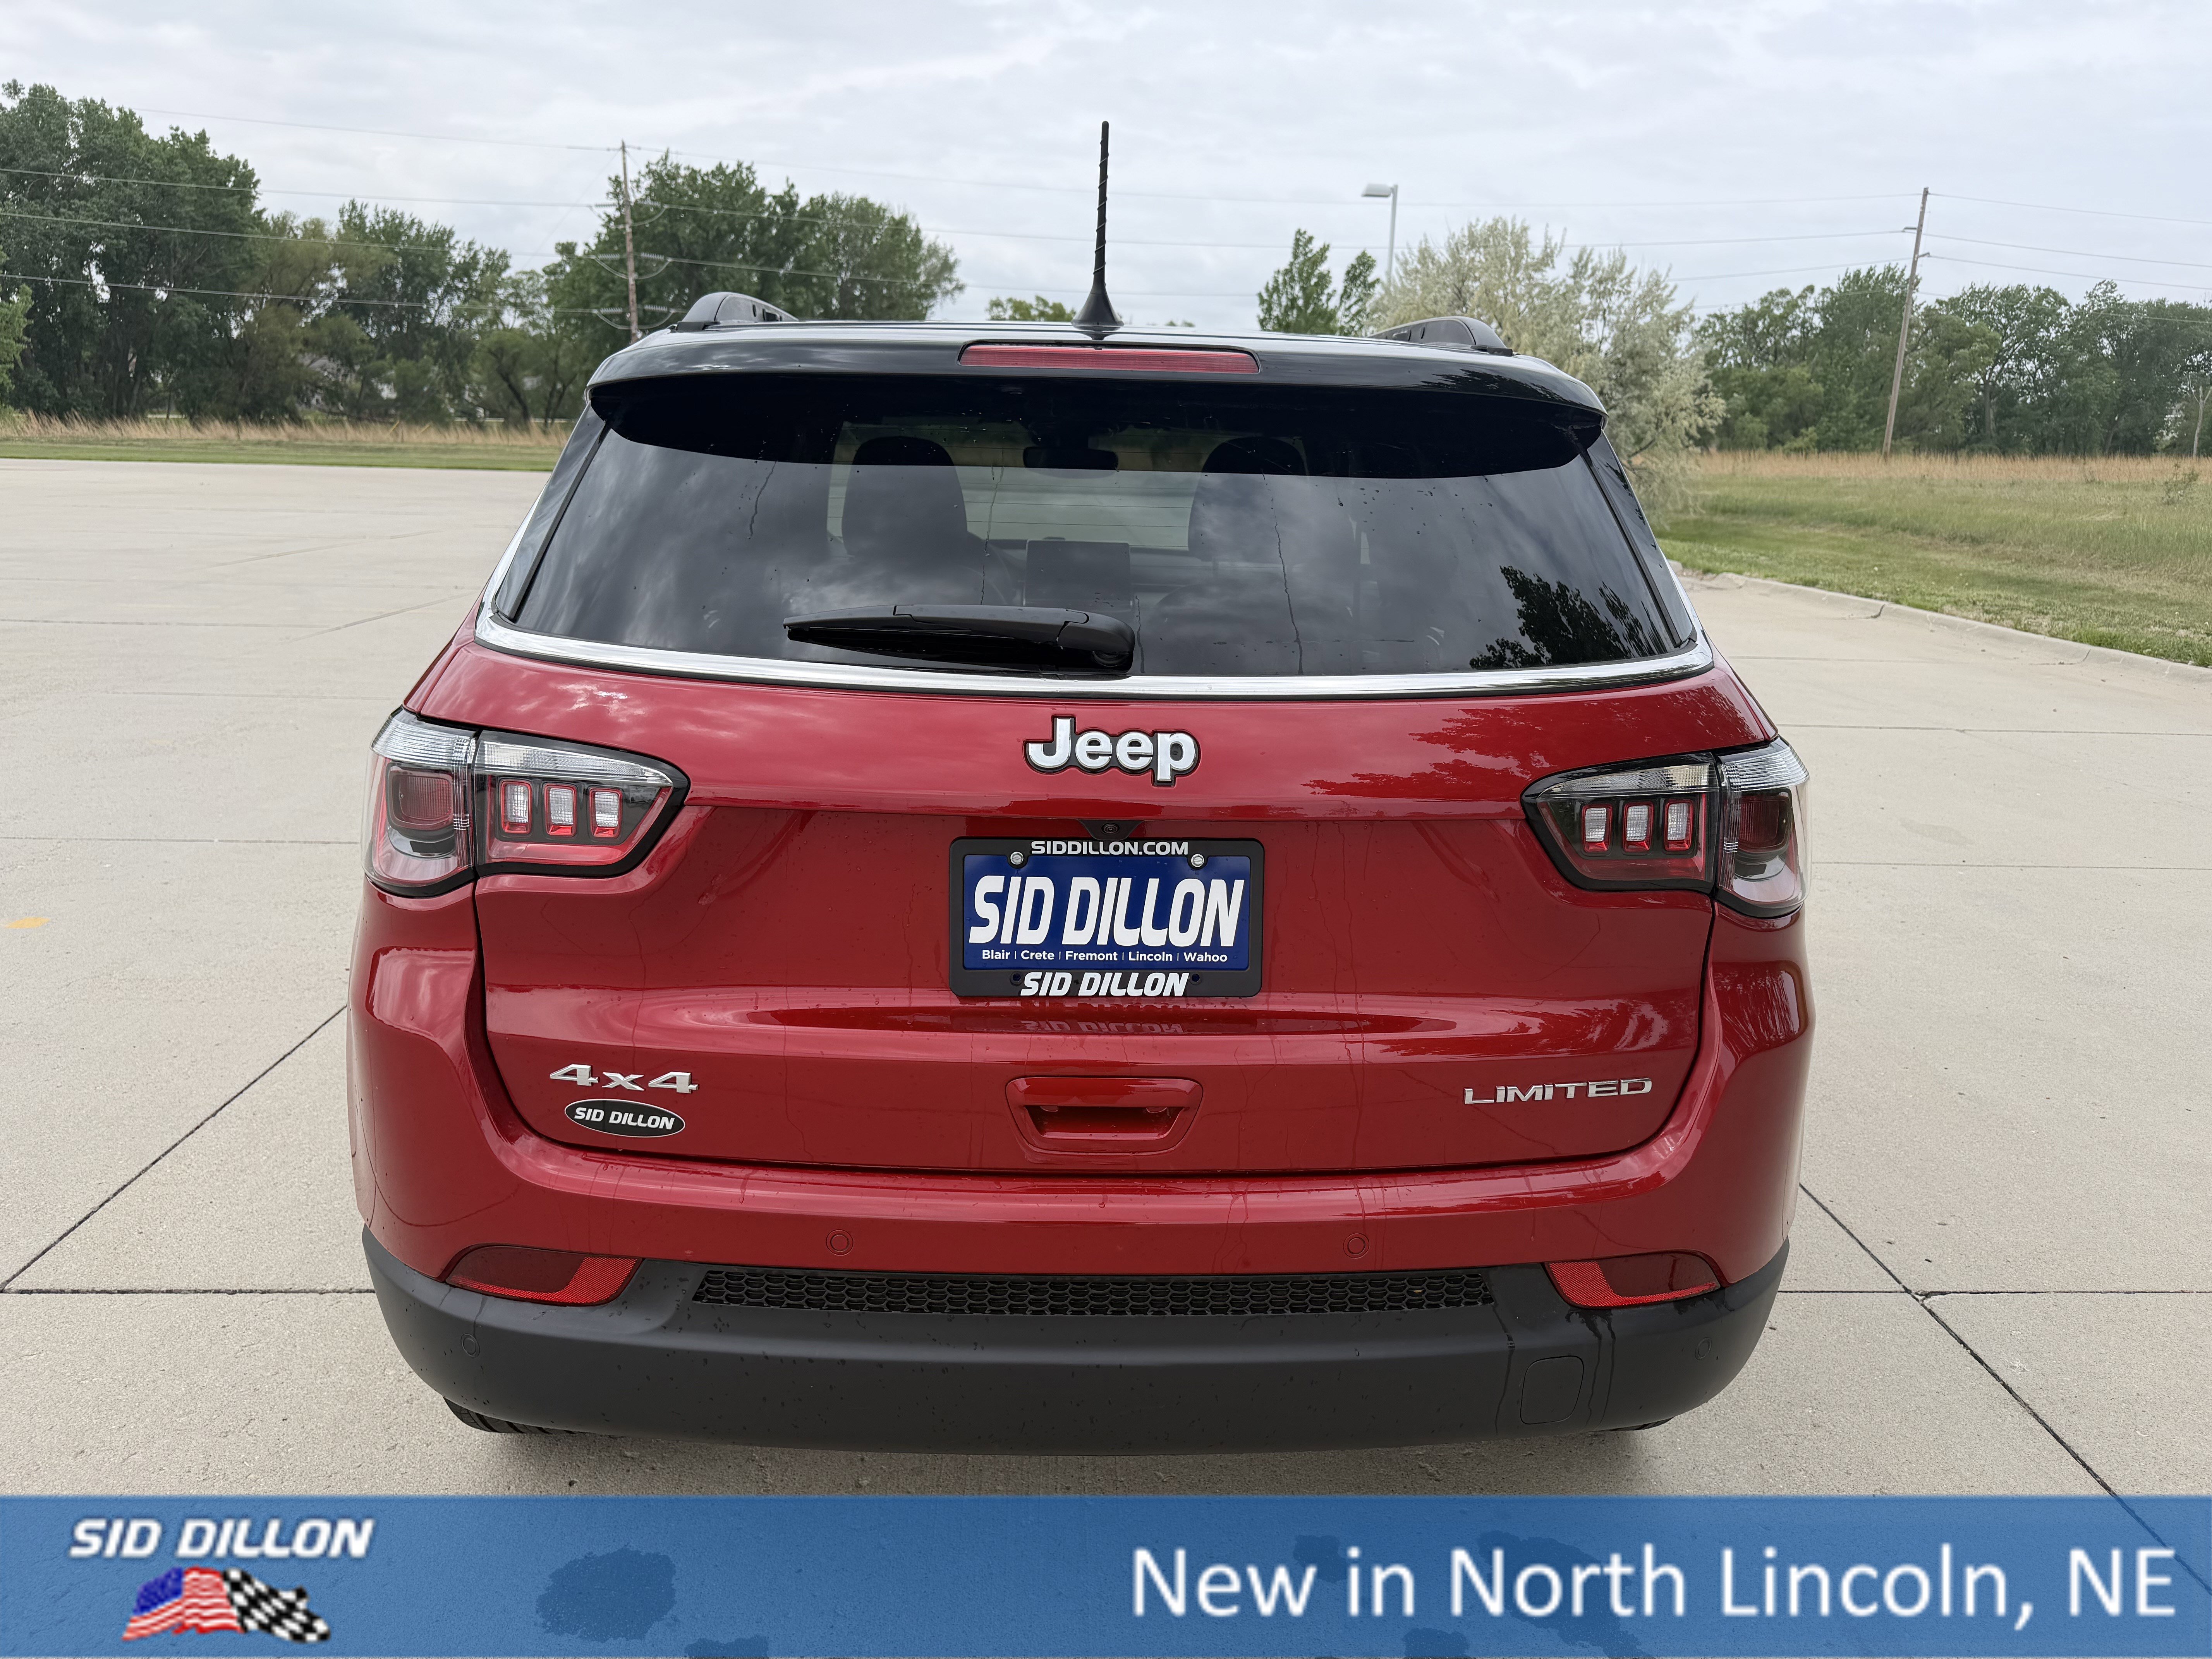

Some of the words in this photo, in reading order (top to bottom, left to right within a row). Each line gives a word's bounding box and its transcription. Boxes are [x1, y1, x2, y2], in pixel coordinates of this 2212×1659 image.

[1027, 717, 1195, 782] Jeep
[1030, 840, 1188, 855] SIDDILLON.COM
[969, 875, 1054, 944] SID
[1062, 877, 1245, 947] DILLON
[982, 949, 1010, 960] Blair
[1021, 950, 1055, 960] Crete
[1066, 951, 1118, 961] Fremont
[1129, 951, 1173, 961] Lincoln
[1183, 952, 1228, 962] Wahoo
[1020, 972, 1072, 996] SID
[1077, 972, 1189, 996] DILLON
[550, 1064, 699, 1094] 4x4
[1464, 1077, 1652, 1104] LIMITED
[574, 1107, 605, 1121] SID
[609, 1111, 675, 1130] DILLON
